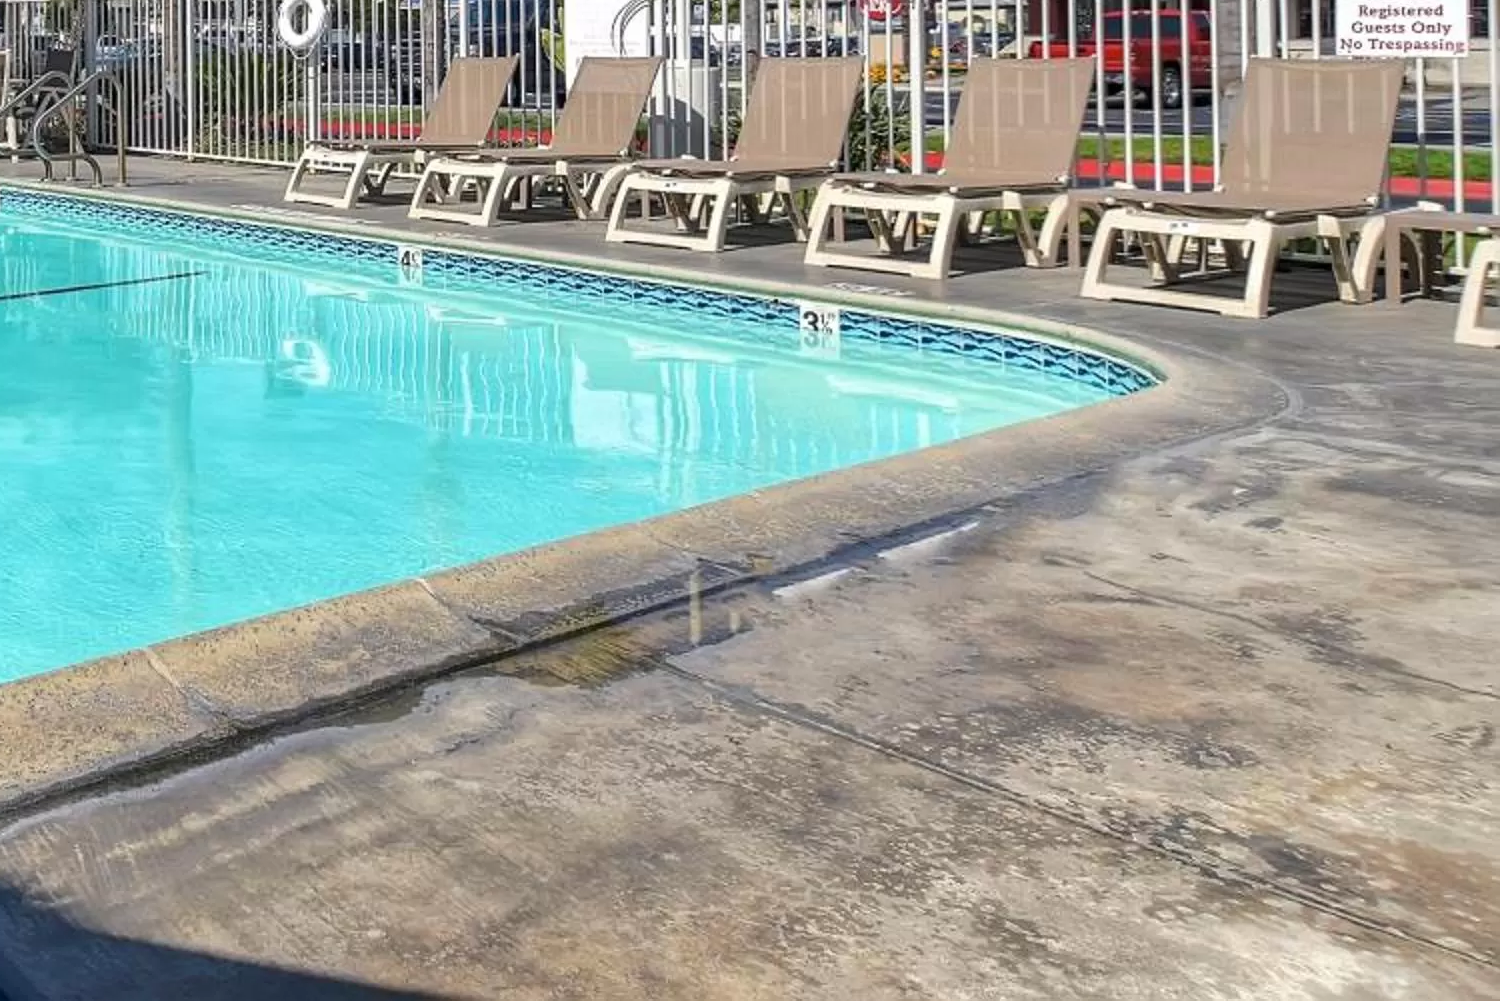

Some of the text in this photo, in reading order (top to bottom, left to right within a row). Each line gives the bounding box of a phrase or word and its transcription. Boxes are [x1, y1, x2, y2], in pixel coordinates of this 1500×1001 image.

[1358, 4, 1443, 19] Registered
[1351, 21, 1453, 36] Guests Only
[1340, 38, 1465, 54] No Trespassing
[803, 310, 820, 333] 3
